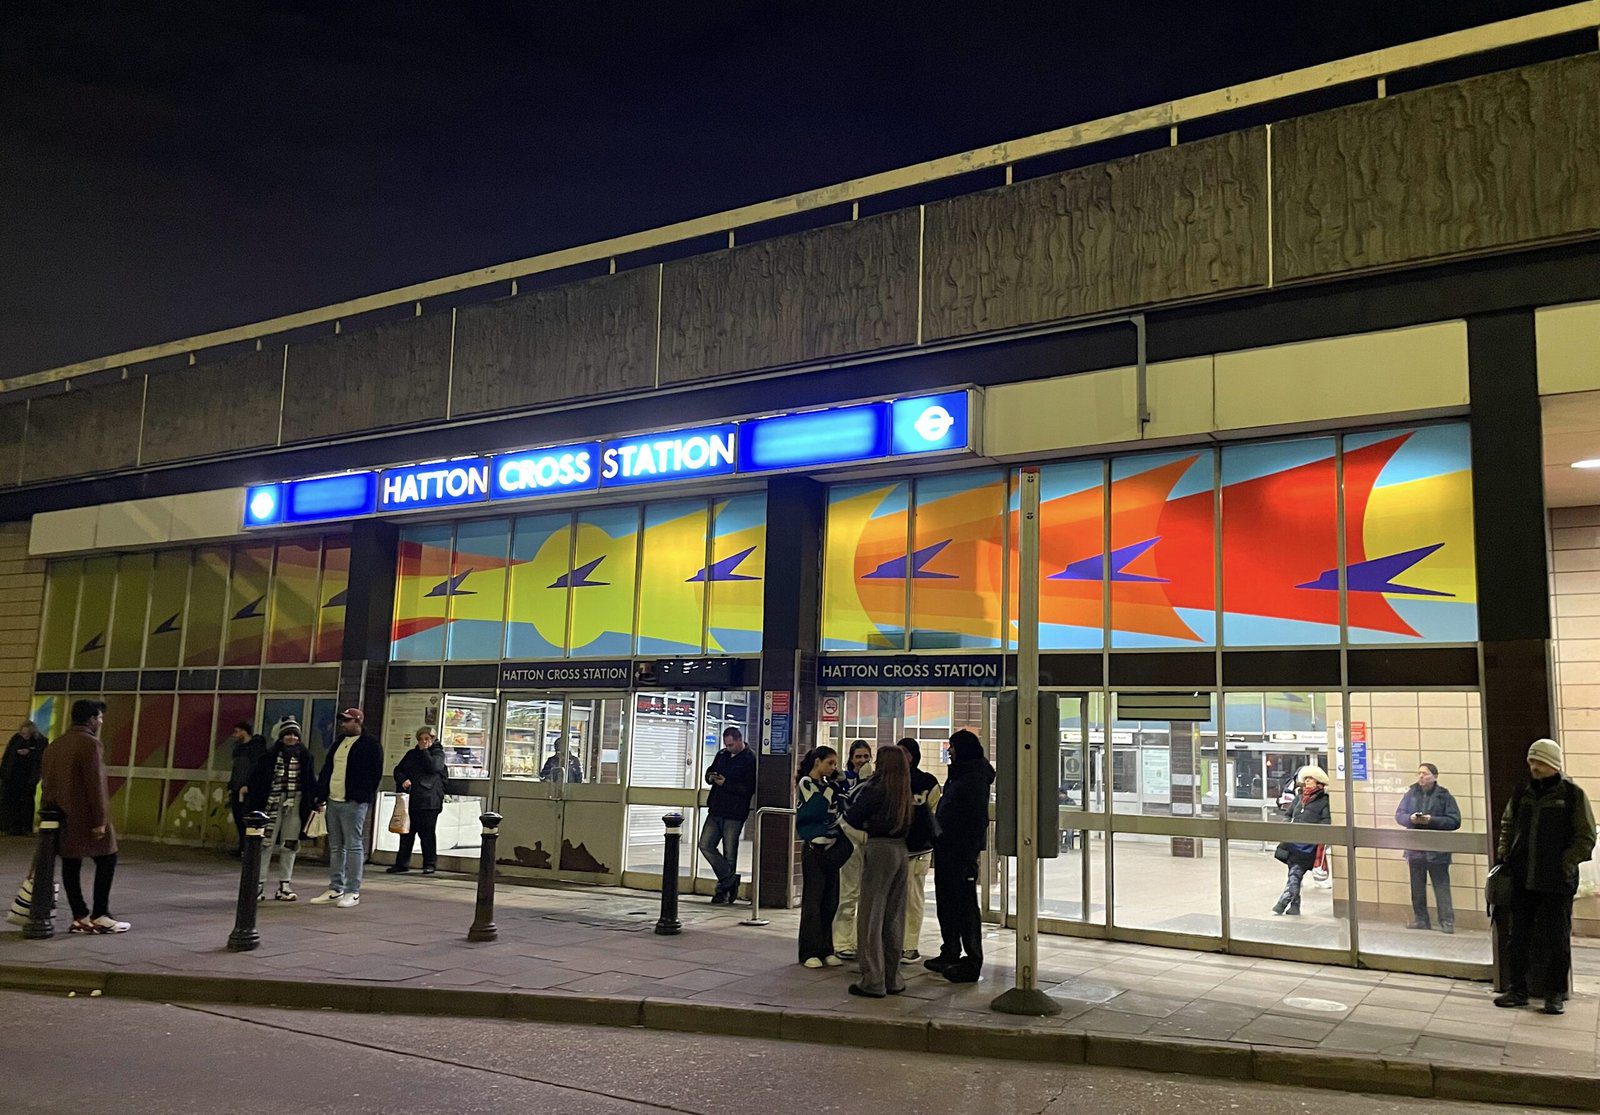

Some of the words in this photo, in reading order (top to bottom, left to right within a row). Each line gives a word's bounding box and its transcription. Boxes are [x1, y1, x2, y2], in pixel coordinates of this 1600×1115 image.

[383, 466, 489, 504] HATTON
[498, 451, 591, 492] CROSS
[602, 433, 735, 479] STATION
[503, 669, 544, 681] HATTON
[547, 669, 580, 680] CROSS
[583, 667, 627, 680] STATION
[822, 665, 878, 678] HATTON
[883, 664, 930, 677] CROSS
[934, 663, 997, 677] STATION
